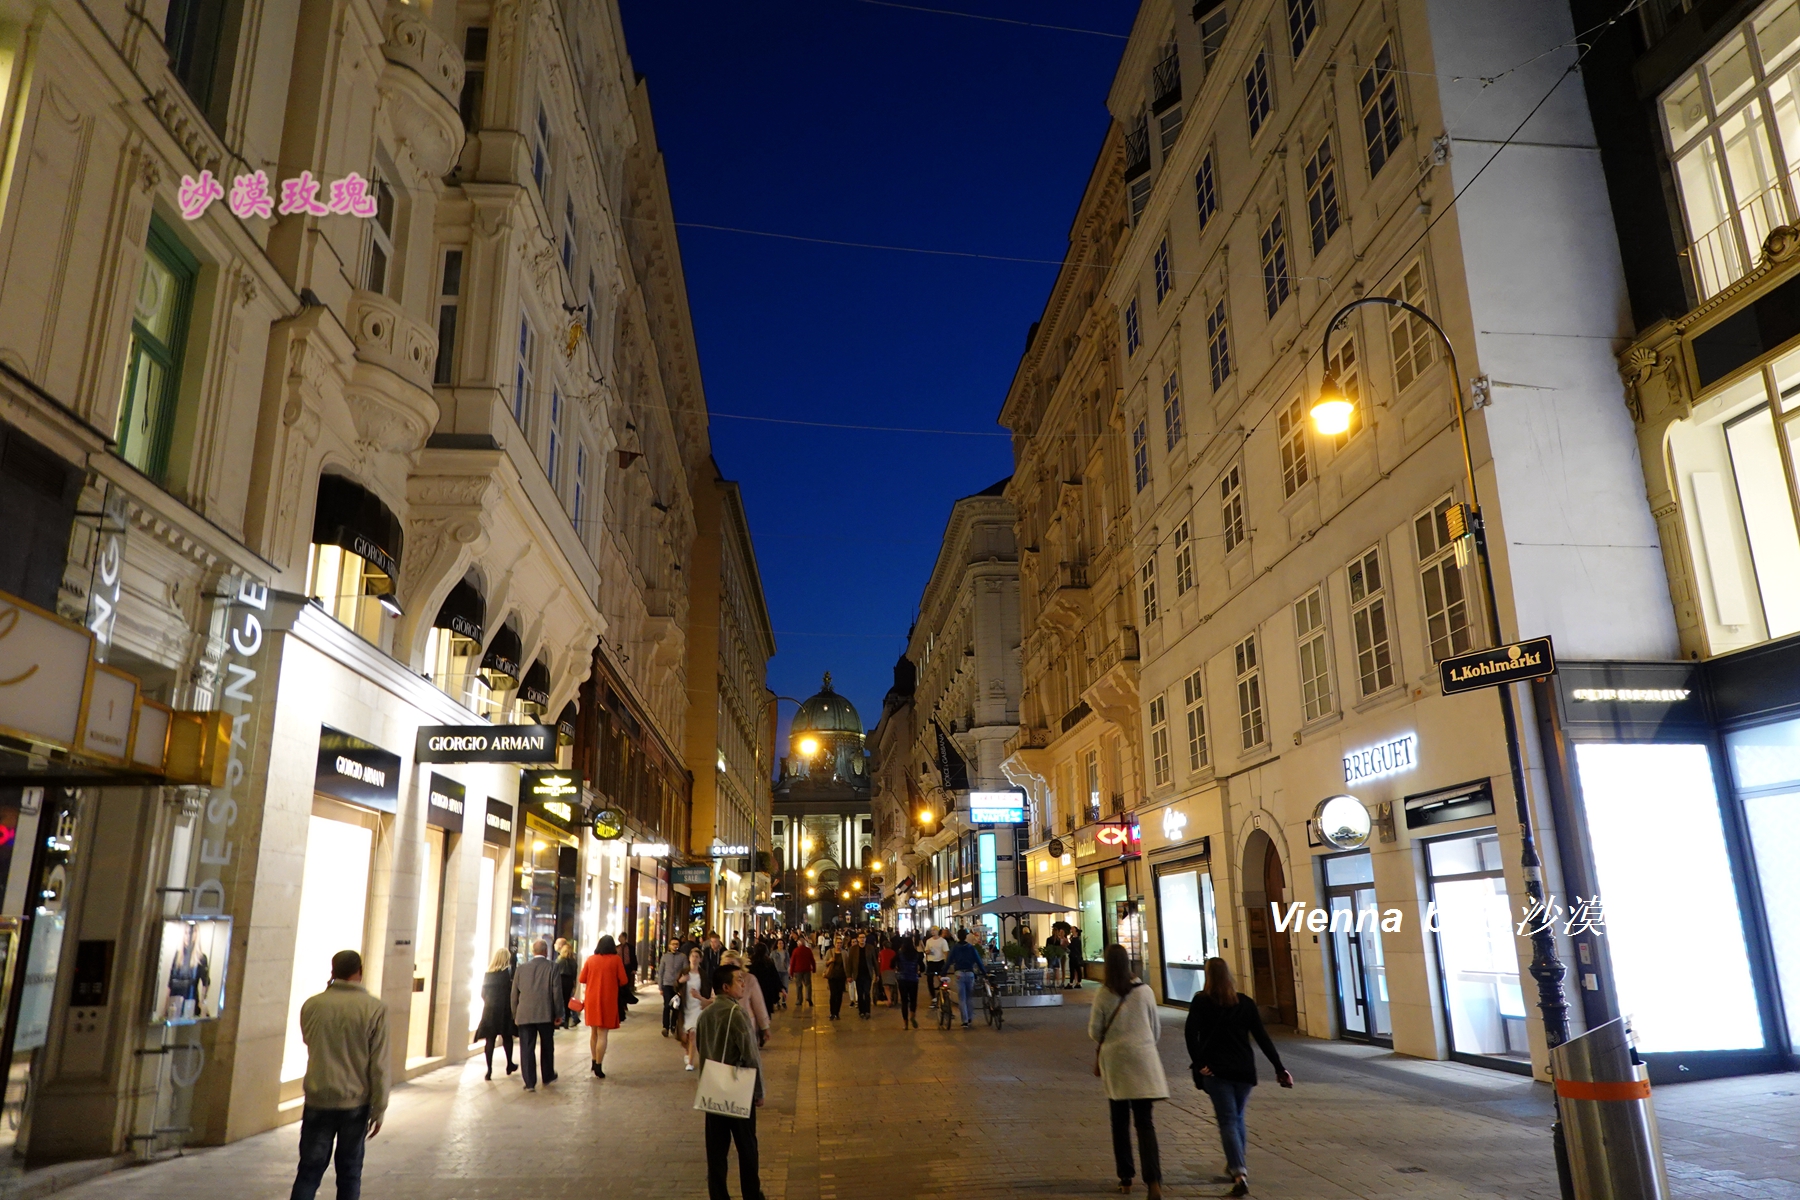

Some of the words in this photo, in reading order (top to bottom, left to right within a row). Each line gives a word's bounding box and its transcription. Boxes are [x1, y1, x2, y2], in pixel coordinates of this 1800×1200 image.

[354, 536, 386, 569] GIORGIO
[192, 578, 270, 916] DESSANGE
[428, 736, 487, 752] GIORGIO
[491, 737, 545, 751] ARMANI
[1343, 737, 1413, 783] BREGUET
[335, 755, 363, 781] GIORGIO
[364, 766, 386, 788] ARMANI
[713, 846, 748, 854] GUCCI
